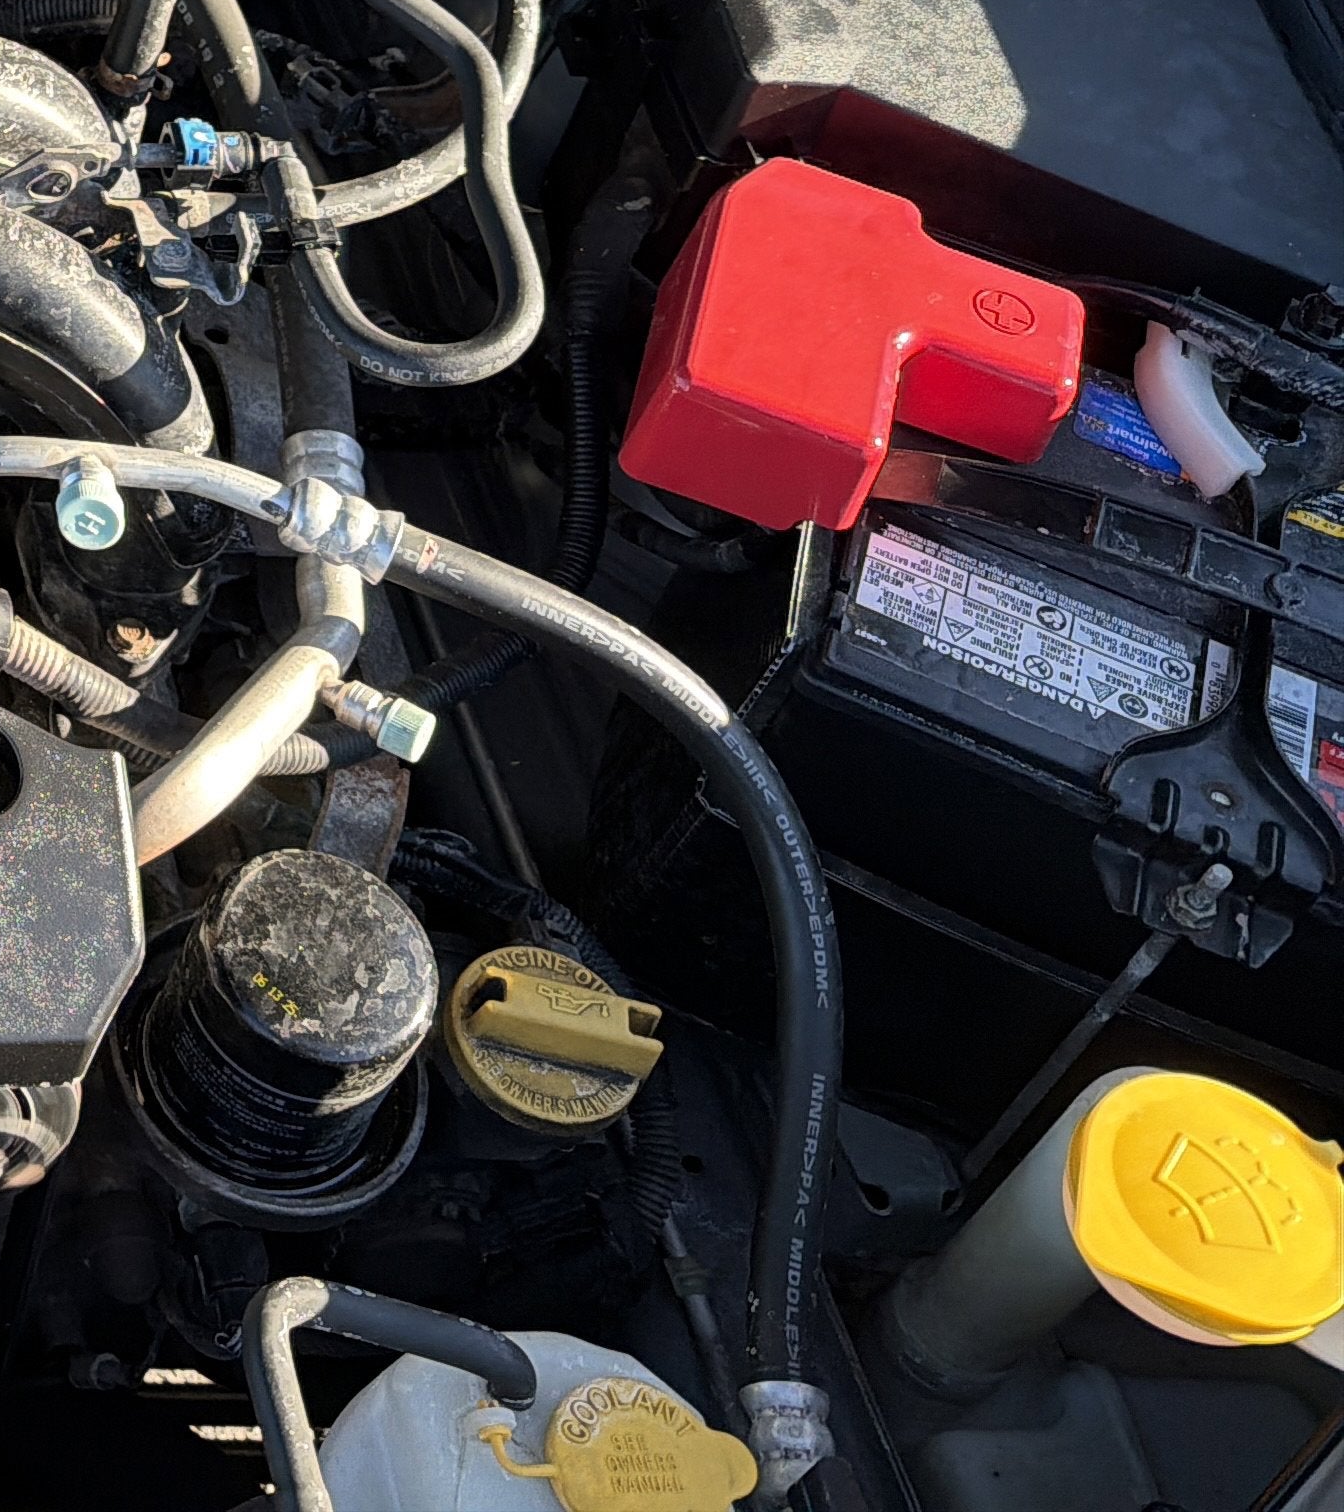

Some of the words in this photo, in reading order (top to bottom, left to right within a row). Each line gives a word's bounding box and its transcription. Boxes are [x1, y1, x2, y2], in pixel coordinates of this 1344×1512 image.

[360, 356, 383, 374] DO
[388, 366, 424, 382] NOT
[1106, 423, 1173, 460] Walmart
[77, 510, 107, 537] H
[871, 545, 908, 565] BATTERY.
[866, 558, 891, 573] FAST.
[910, 561, 931, 575] OPEN
[933, 563, 951, 575] NOT
[863, 574, 880, 586] GET
[865, 566, 904, 587] MEDICAL
[892, 569, 915, 583] HELP
[932, 571, 949, 582] NOT
[951, 570, 964, 580] DO
[950, 578, 962, 588] DO
[878, 587, 913, 607] WATER.
[974, 580, 1032, 610] INSTRUCTIONS.
[994, 597, 1009, 608] ALL
[876, 595, 936, 625] IMMEDIATELY
[881, 606, 905, 621] EYES
[914, 602, 938, 617] WITH
[961, 607, 973, 616] OR
[1009, 603, 1031, 616] READ
[907, 617, 934, 632] FLUSH
[974, 612, 1017, 635] BLINDNESS
[989, 610, 1018, 627] SEVERE
[973, 620, 998, 635] CAUSE
[992, 636, 1014, 651] ACID
[999, 630, 1016, 642] CAN
[1089, 637, 1105, 648] THE
[969, 636, 1013, 660] SULFURIC
[1105, 644, 1117, 653] OF
[1118, 641, 1129, 649] OF
[1118, 648, 1135, 660] OUT
[1129, 645, 1157, 661] REACH
[1136, 656, 1157, 669] KEEP
[920, 632, 1086, 713] DANGER/POISON
[1058, 671, 1072, 682] NO
[1096, 661, 1141, 685] BLINDNESS
[1104, 674, 1134, 691] GASES
[1143, 681, 1169, 696] CAUSE
[1135, 686, 1186, 713] EXPLOSIVE
[1170, 692, 1187, 703] CAN
[480, 947, 569, 976] ENGINE
[250, 970, 270, 989] 06
[266, 984, 285, 1003] 13
[471, 1047, 503, 1082] SEE
[571, 1082, 631, 1117] MANUAL
[559, 1386, 698, 1444] COOLANT
[609, 1433, 648, 1451] SEE
[610, 1475, 686, 1494] MANUAL
